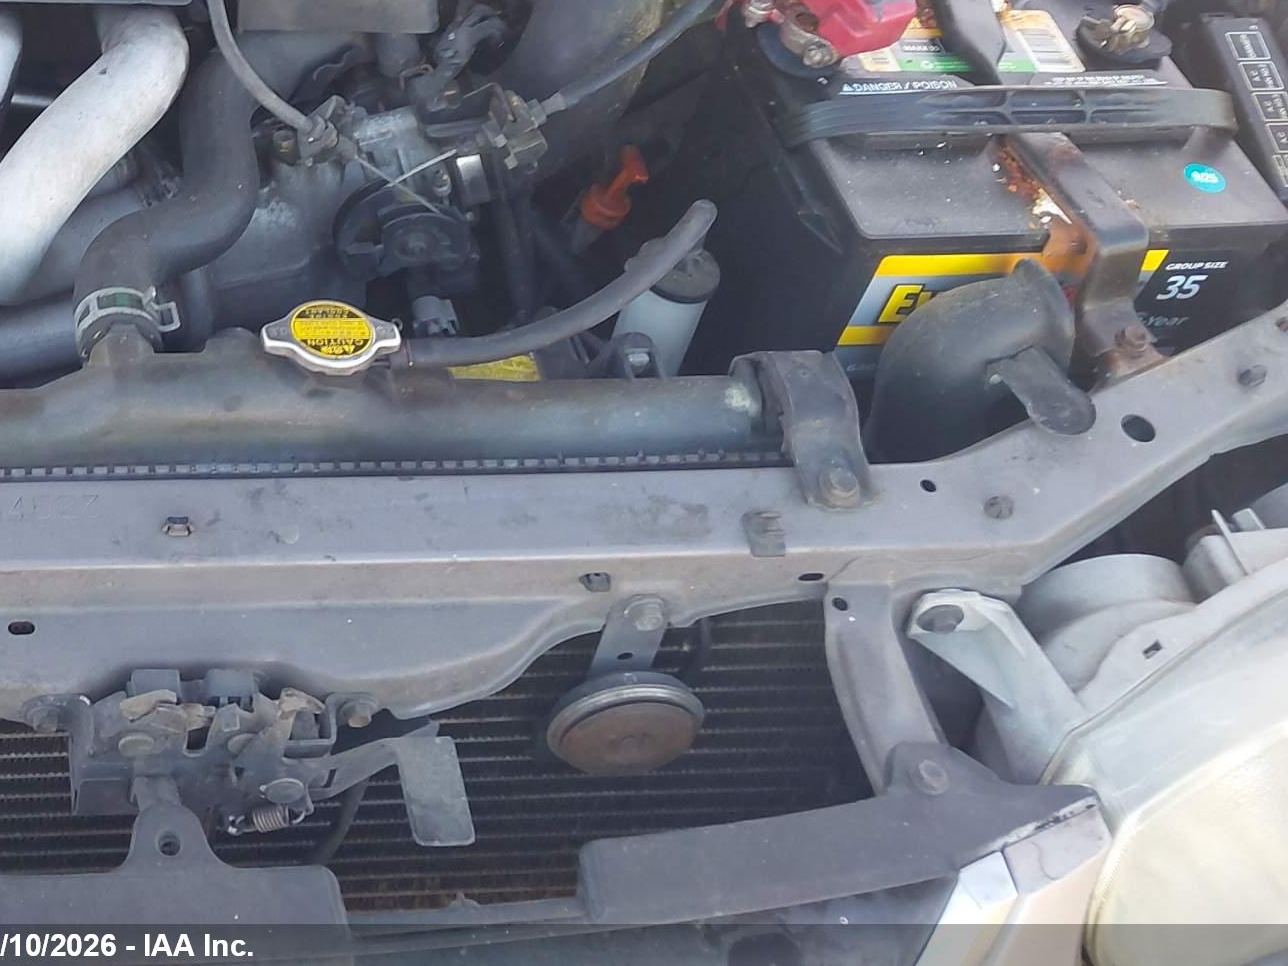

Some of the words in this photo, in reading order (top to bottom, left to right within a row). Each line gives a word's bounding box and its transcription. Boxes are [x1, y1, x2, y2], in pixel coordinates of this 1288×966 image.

[852, 81, 903, 92] DANGER
[912, 79, 958, 91] POISON
[1165, 262, 1205, 271] GROUP
[1204, 261, 1229, 270] SIZE
[1155, 274, 1209, 300] 35
[307, 338, 364, 347] CAUTION
